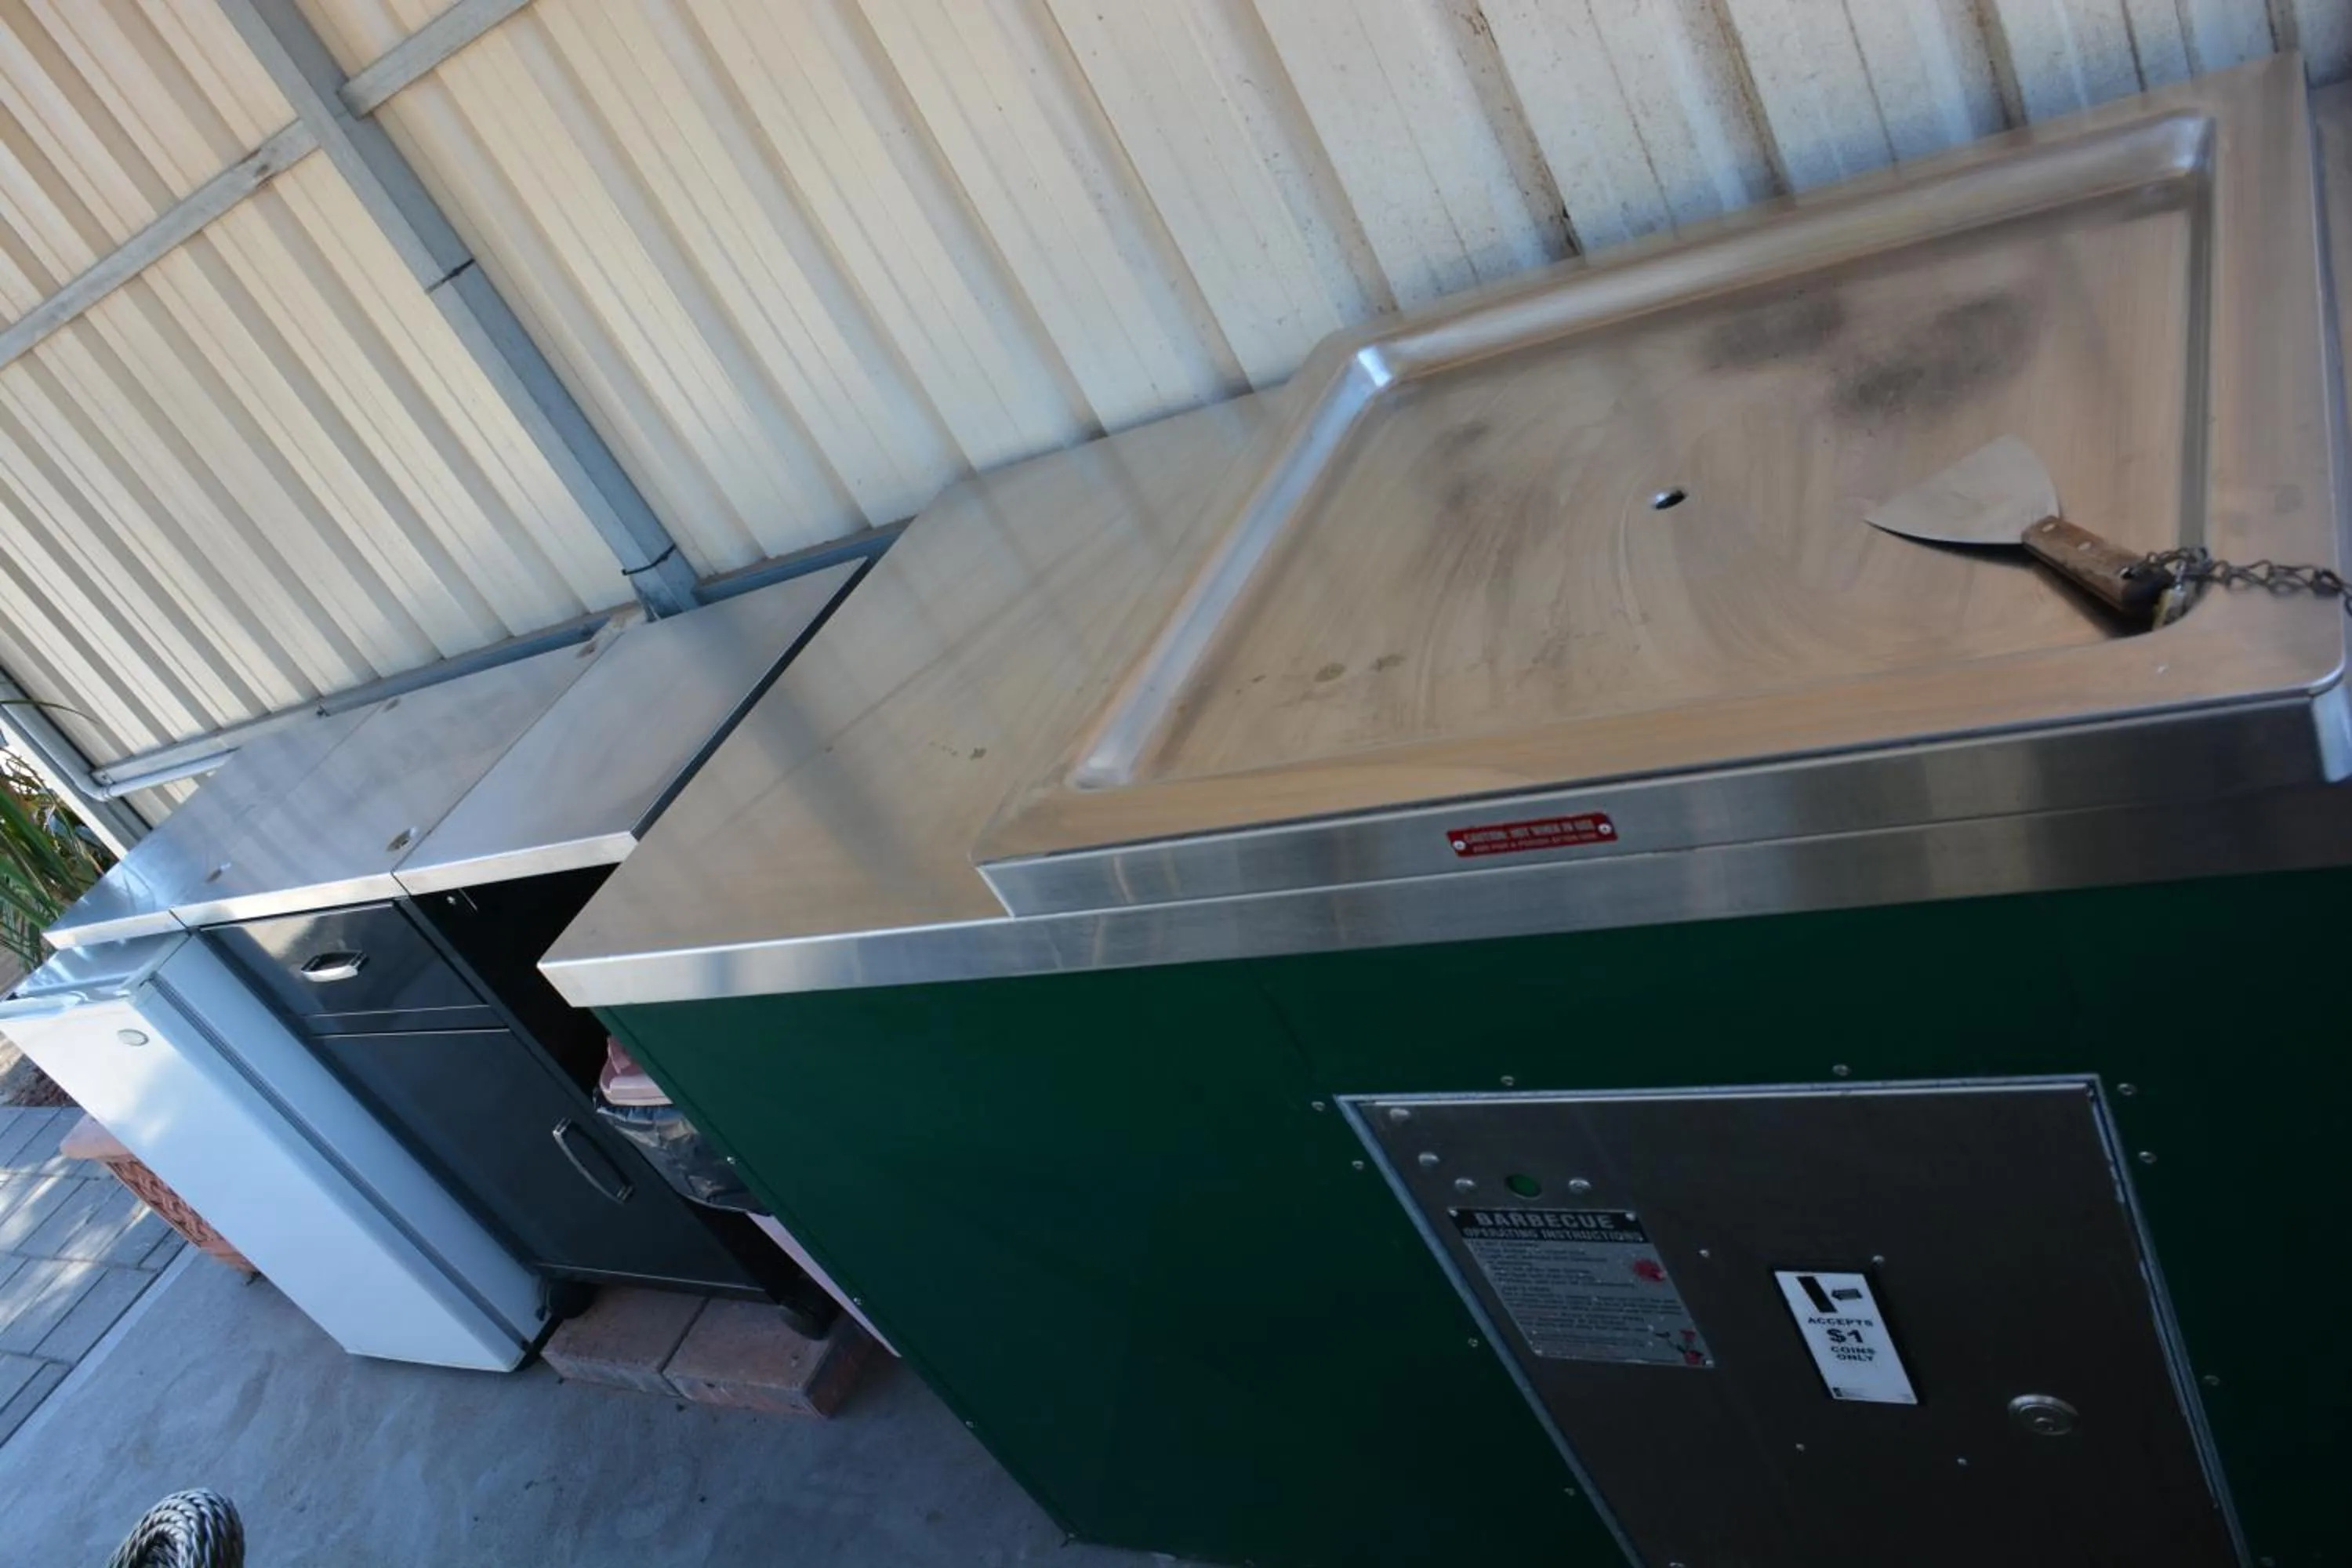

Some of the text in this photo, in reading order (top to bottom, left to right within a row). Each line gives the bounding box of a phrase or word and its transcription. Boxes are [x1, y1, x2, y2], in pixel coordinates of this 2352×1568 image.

[1474, 1212, 1615, 1229] BARBECUE
[1540, 1229, 1644, 1242] INSTRUCTIONS
[1808, 1317, 1874, 1327] ACCEPTS
[1827, 1329, 1864, 1343] $1
[1831, 1346, 1876, 1356] COINS
